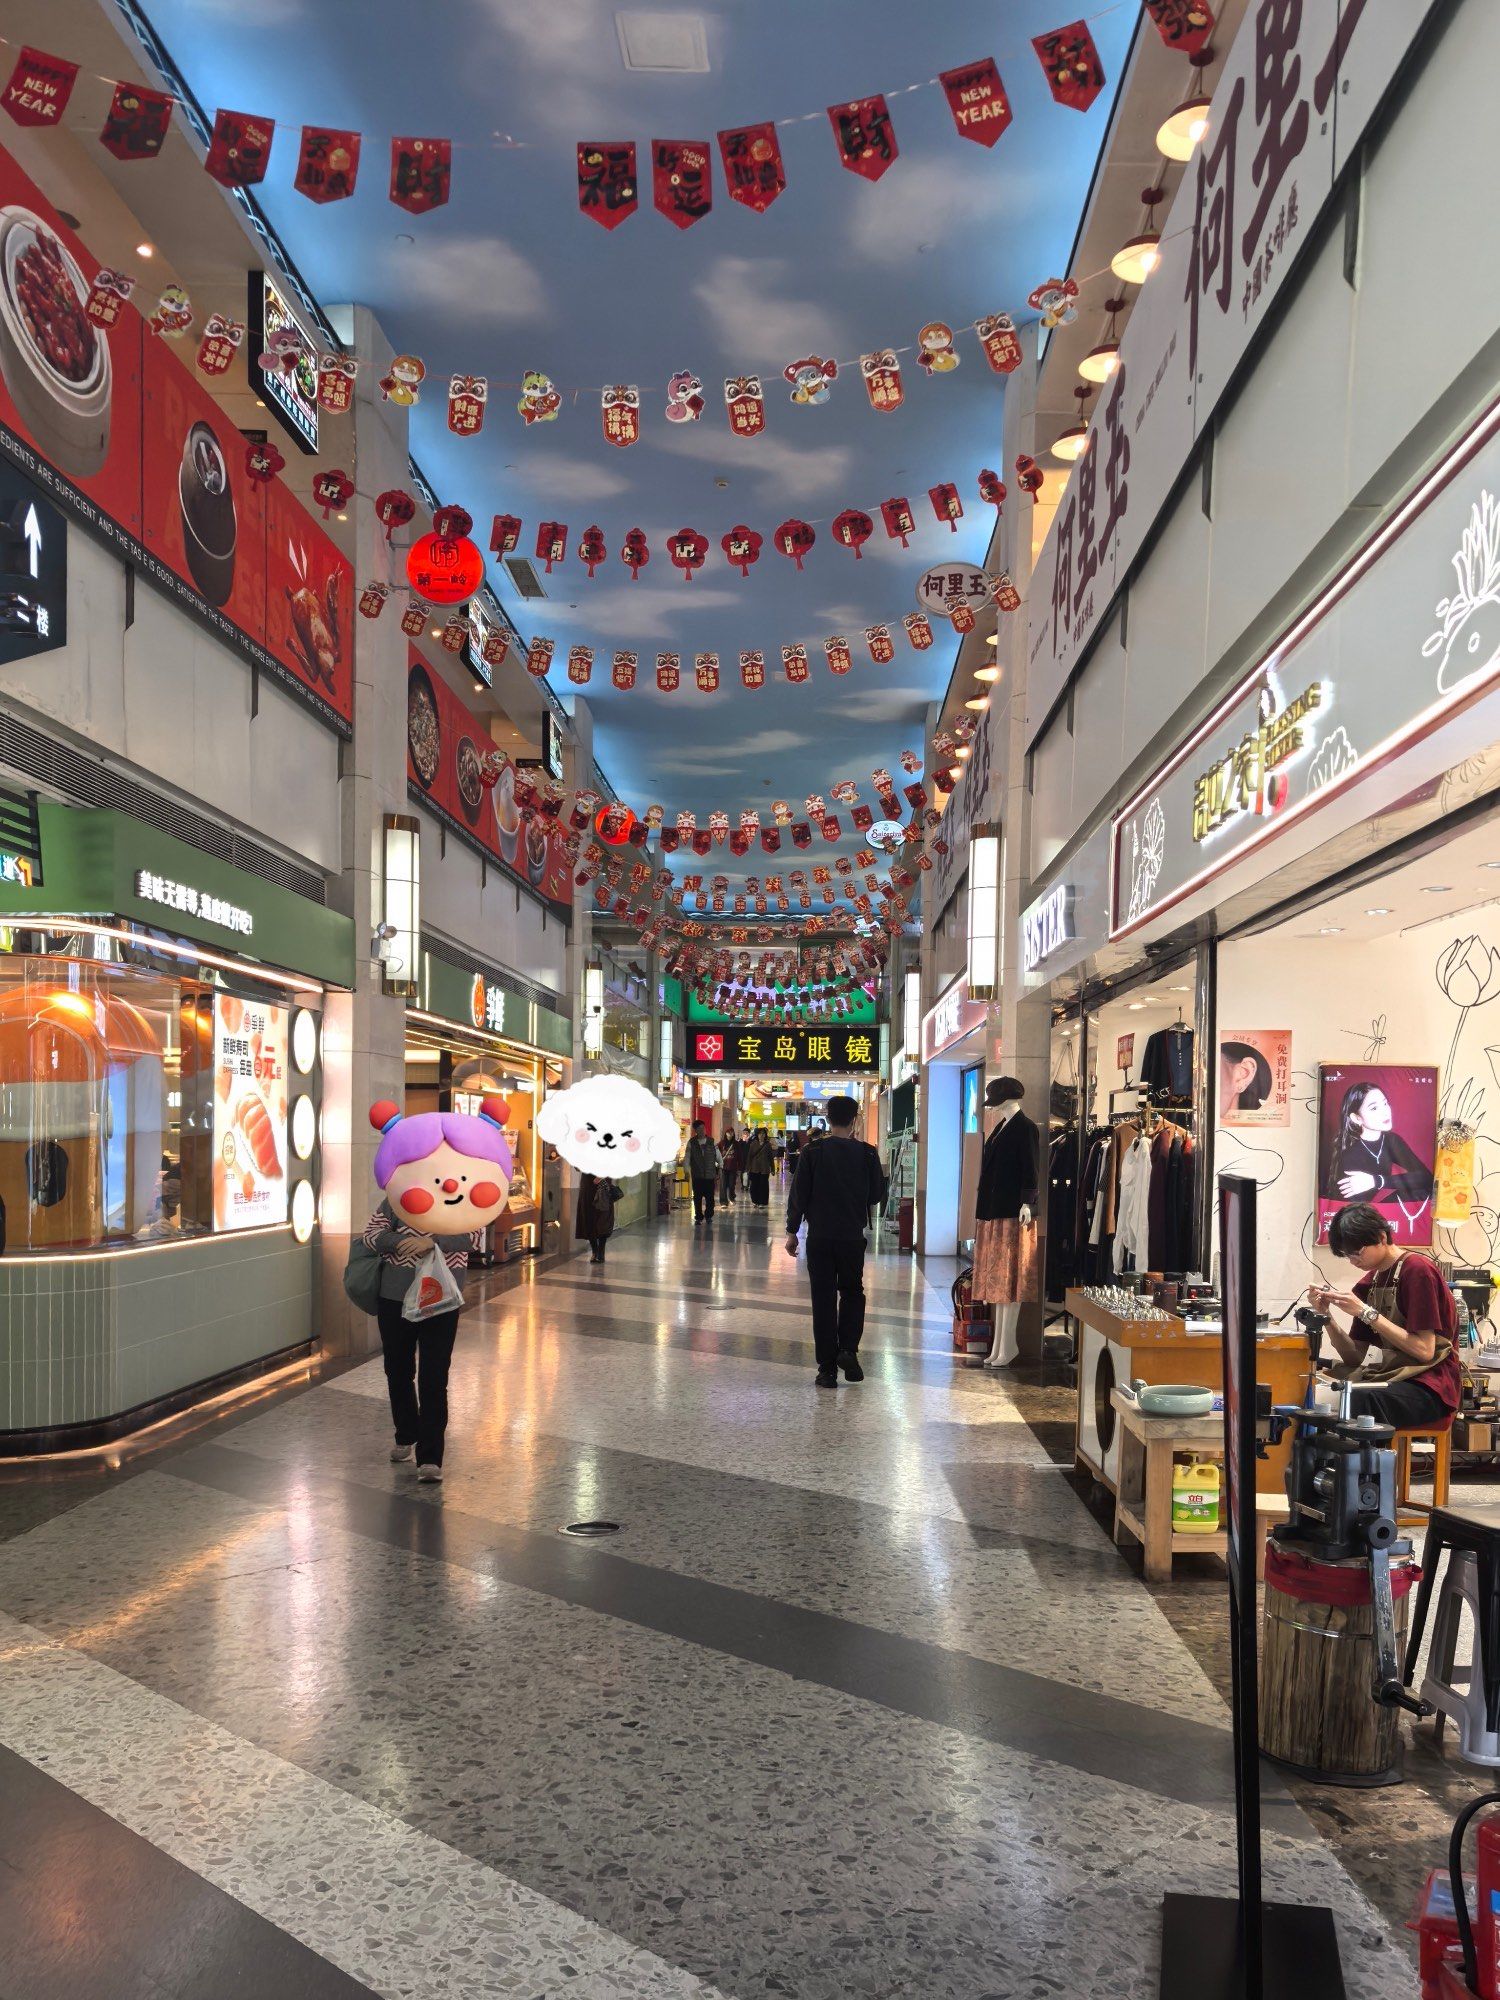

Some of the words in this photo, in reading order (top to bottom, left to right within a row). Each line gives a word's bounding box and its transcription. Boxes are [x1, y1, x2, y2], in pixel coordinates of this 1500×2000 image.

[24, 77, 57, 97] NEW
[960, 85, 991, 104] NEW
[10, 87, 57, 117] YEAR
[956, 101, 1006, 126] YEAR
[683, 148, 706, 166] GOOD
[1184, 0, 1366, 382] 何里
[454, 399, 478, 416] 财源
[607, 408, 632, 423] 福气
[453, 414, 476, 429] 广进
[607, 421, 635, 439] 满满
[1051, 362, 1130, 662] 何里玉
[37, 464, 53, 485] ARE
[55, 478, 96, 521] SUFFICIENT
[98, 517, 113, 536] AND
[115, 529, 128, 549] THE
[219, 617, 233, 637] TASTE
[923, 573, 986, 597] 何里玉
[824, 828, 839, 836] YEAR
[1023, 885, 1066, 973] SISTER
[737, 1035, 873, 1064] 宝岛眼镜
[1275, 1043, 1288, 1104] 免费打耳洞
[1187, 1494, 1203, 1502] 立白
